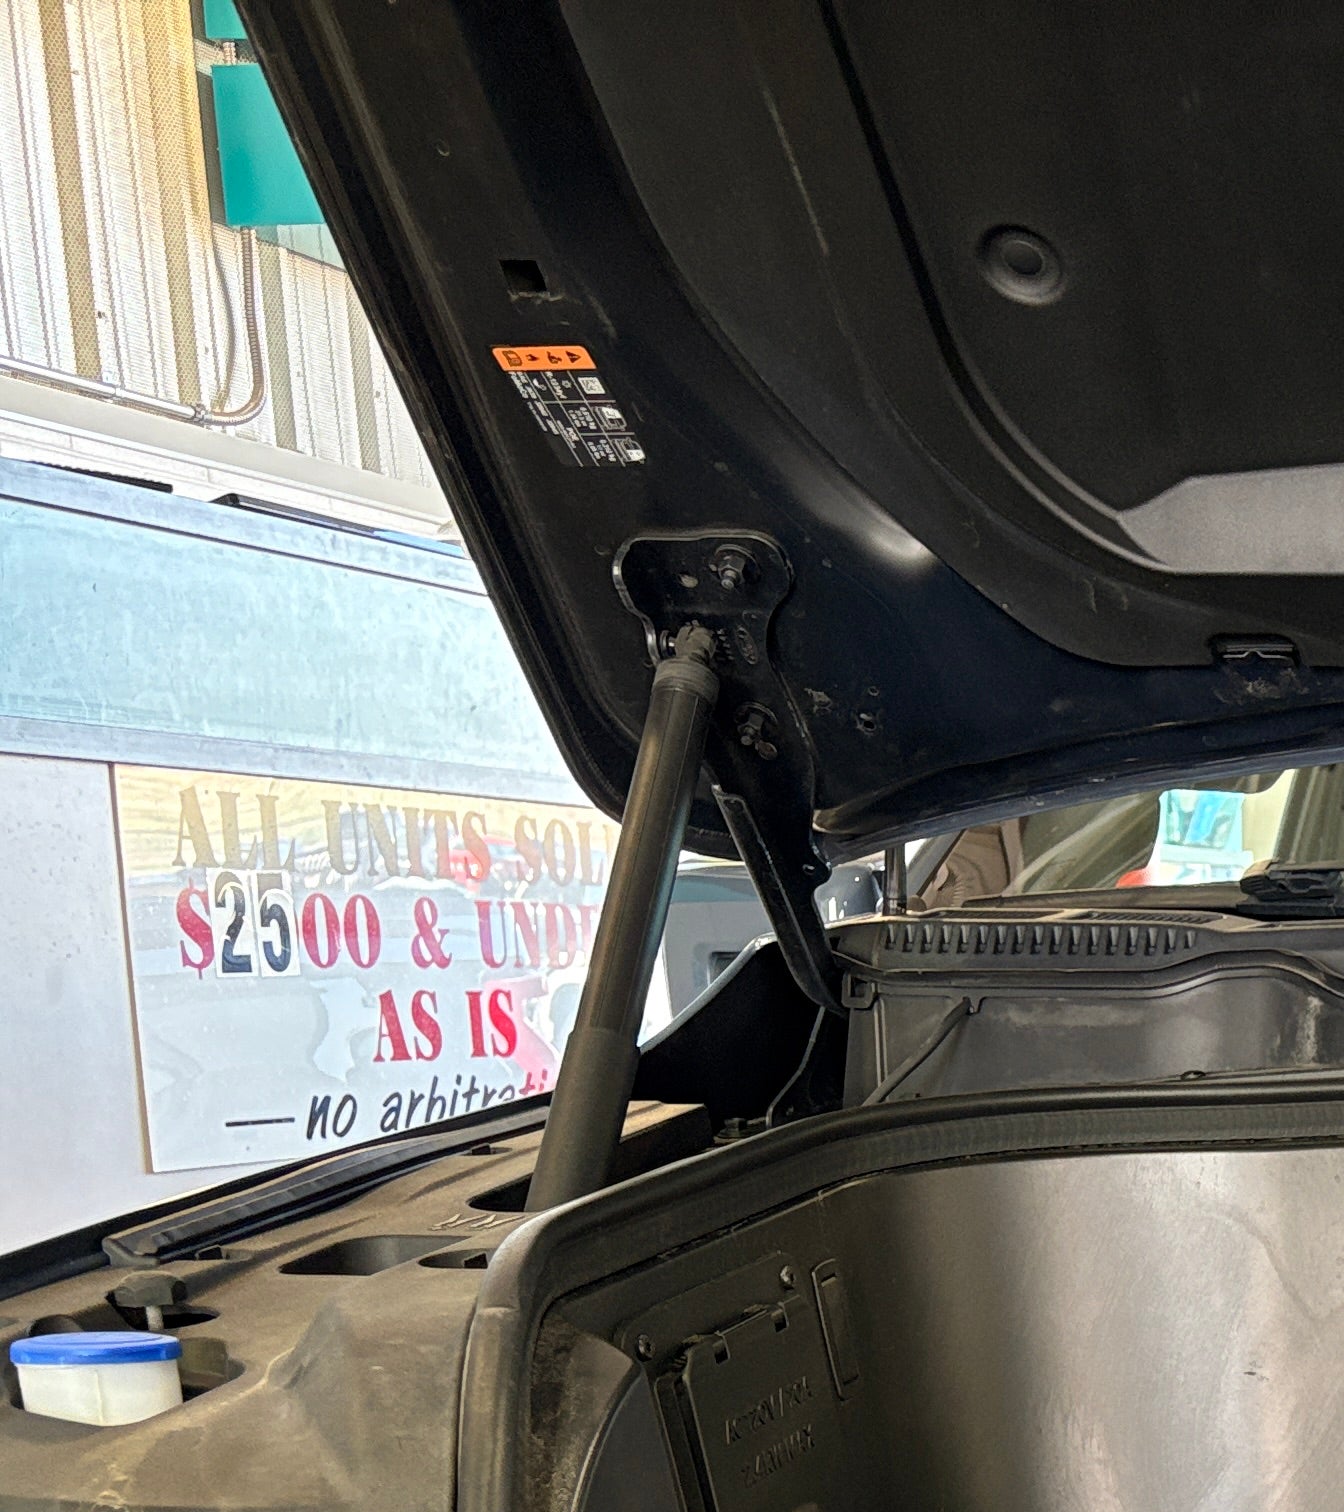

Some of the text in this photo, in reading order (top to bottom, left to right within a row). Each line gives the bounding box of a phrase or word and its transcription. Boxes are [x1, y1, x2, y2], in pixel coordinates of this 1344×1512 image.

[172, 785, 617, 886] ALL UNITS SOL
[176, 872, 381, 979] $2500
[411, 896, 452, 969] &
[373, 988, 518, 1062] AS IS
[306, 1093, 358, 1140] no
